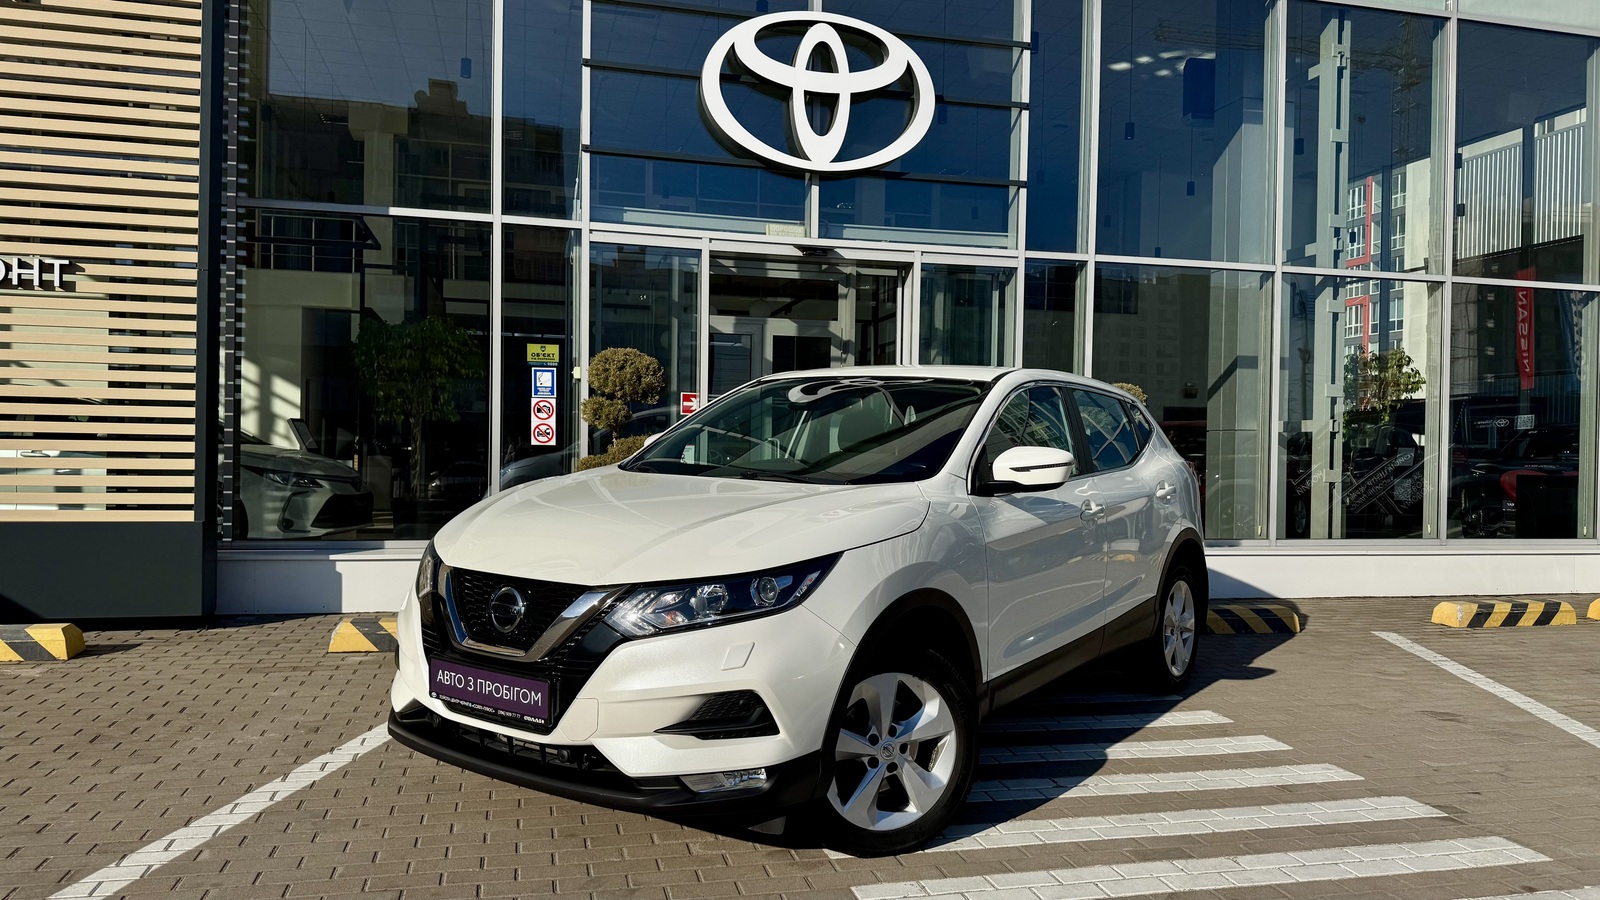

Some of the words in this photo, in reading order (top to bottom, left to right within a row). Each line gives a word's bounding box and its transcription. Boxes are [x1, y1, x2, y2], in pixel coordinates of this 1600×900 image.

[0, 257, 70, 287] НТ
[437, 669, 464, 688] АВТО
[477, 679, 542, 706] ПРОБІГОМ
